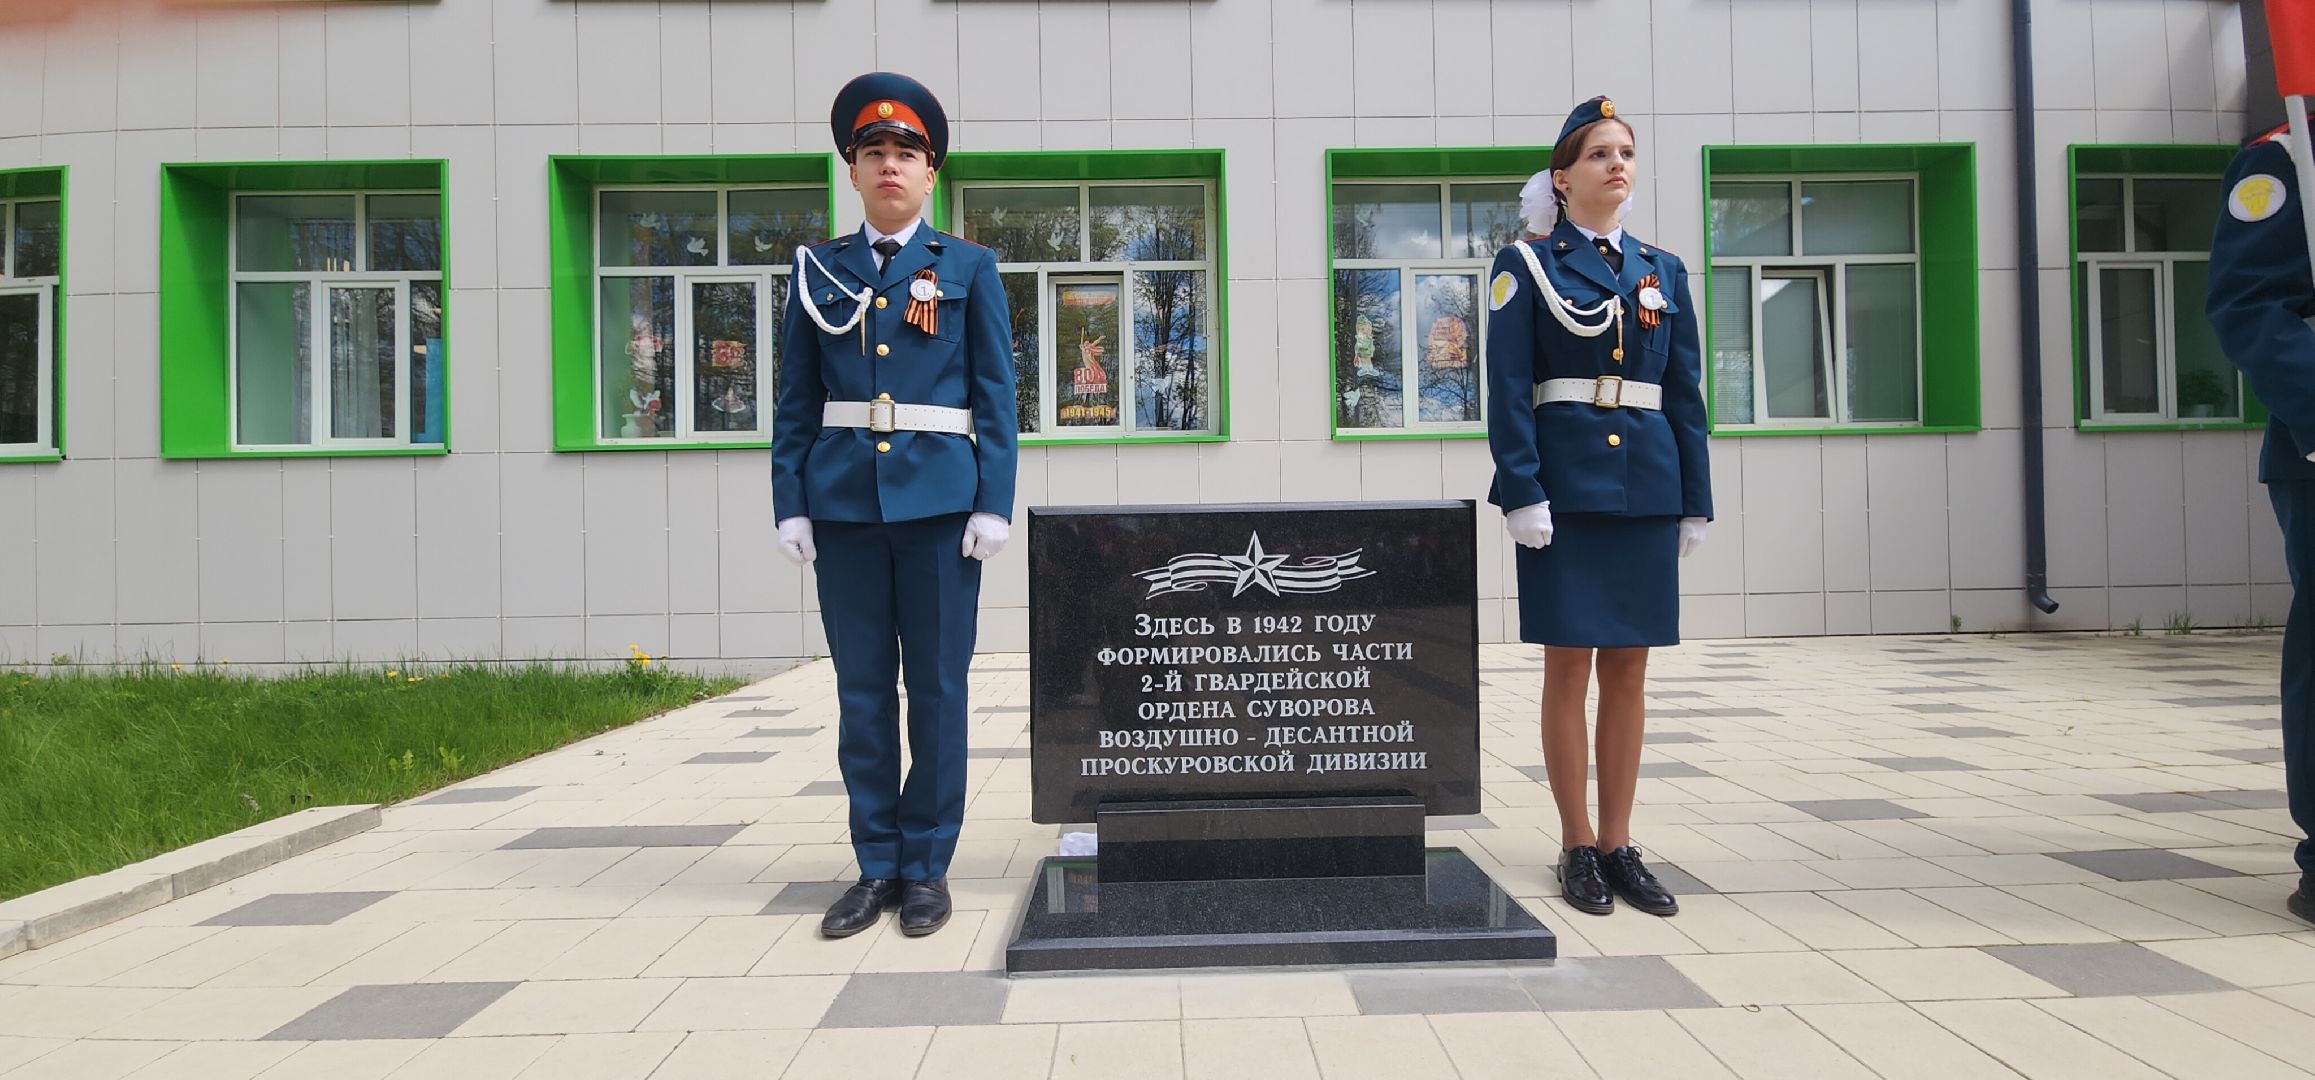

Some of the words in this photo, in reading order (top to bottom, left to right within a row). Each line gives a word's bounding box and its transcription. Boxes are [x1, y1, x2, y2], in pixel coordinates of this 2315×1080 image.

[1135, 614, 1214, 639] ЗДЕСЬ
[1227, 617, 1241, 634] В
[1254, 616, 1302, 634] 1942
[1315, 614, 1376, 635] ГОДУ
[1097, 645, 1321, 666] ФОРМИРОВАЛИСЬ
[1333, 643, 1413, 661] ЧАСТИ
[1141, 670, 1182, 692] 2-Й
[1195, 666, 1370, 694] ГВАРДЕЙСКОЙ
[1138, 700, 1235, 723] ОРДЕНА
[1247, 699, 1375, 717] СУВОРОВА
[1099, 728, 1238, 751] ВОЗДУШНО
[1264, 720, 1414, 749] ДЕСАНТНОЙ
[1080, 750, 1294, 776] ПРОСКУРОВСКОЙ
[1306, 752, 1427, 775] ДИВИЗИИ
